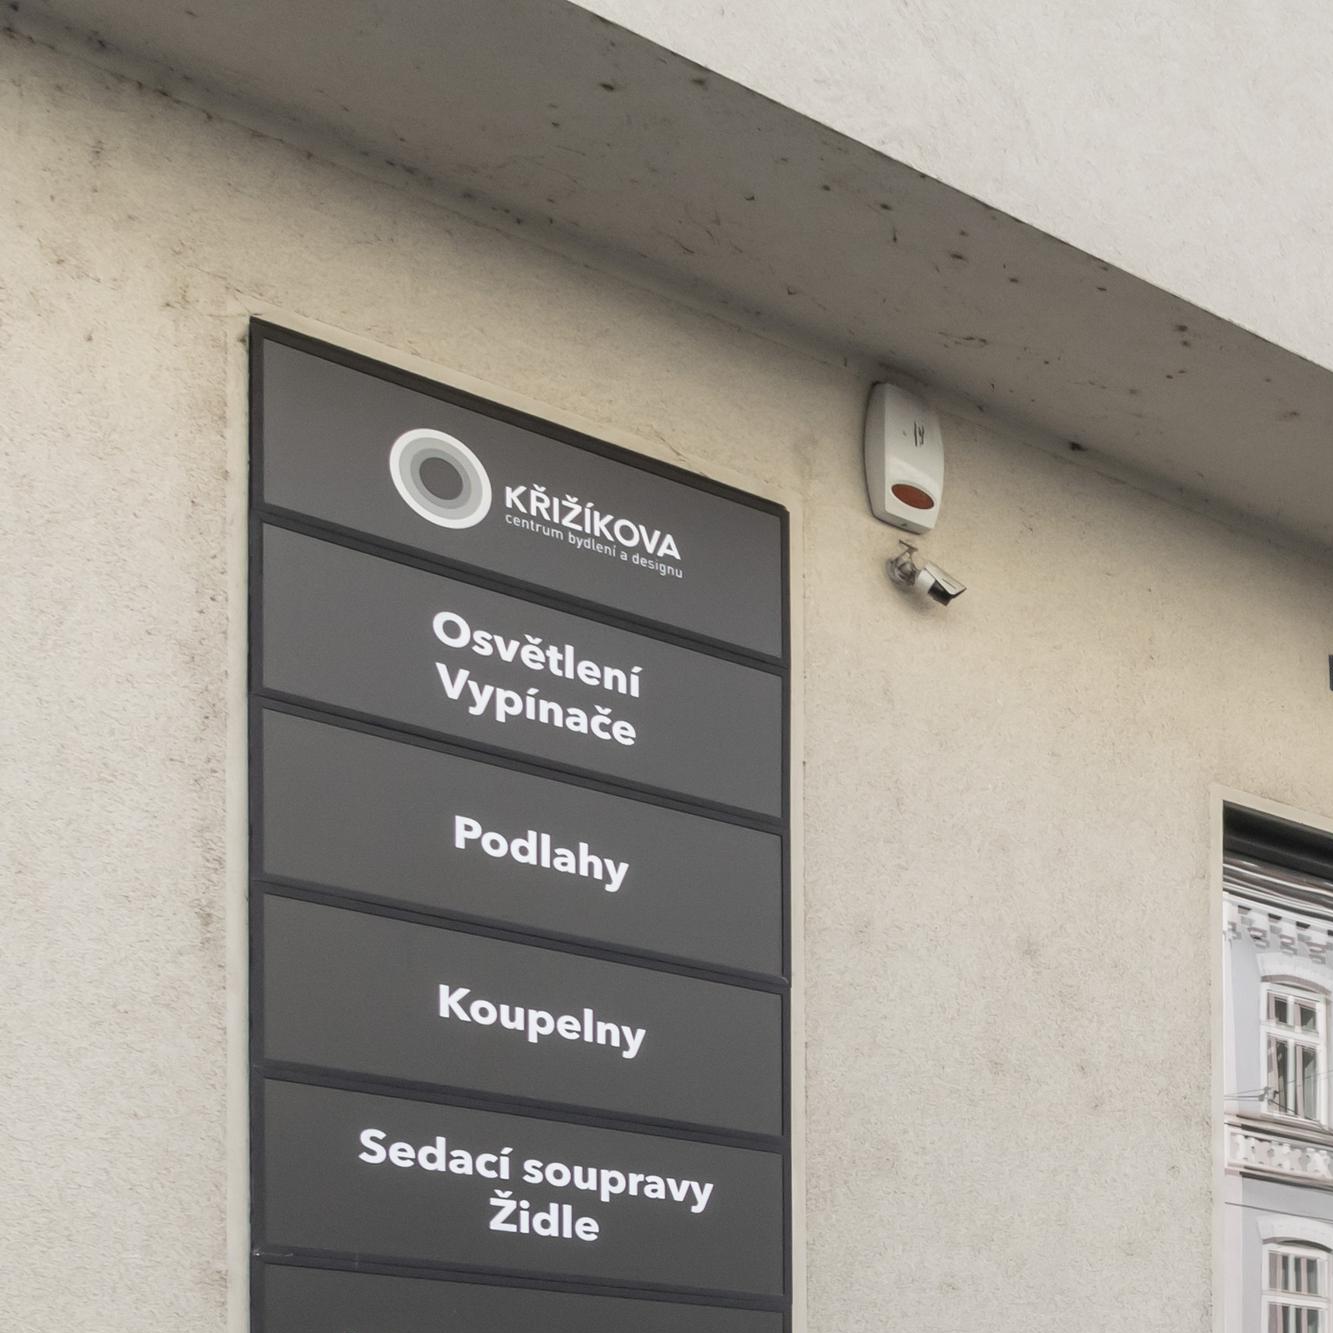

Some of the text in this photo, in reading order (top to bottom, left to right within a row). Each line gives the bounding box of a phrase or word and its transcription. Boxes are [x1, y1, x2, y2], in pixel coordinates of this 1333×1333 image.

[505, 485, 682, 561] KŘIŽÍKOVA
[505, 513, 684, 579] centrum bydlení a designu
[432, 611, 642, 699] Osvětlení
[435, 663, 637, 747] Vypínače
[454, 815, 629, 891] Podlahy
[438, 985, 647, 1059] Koupelny
[358, 1127, 714, 1213] Sedací soupravy
[488, 1189, 601, 1243] Židle
